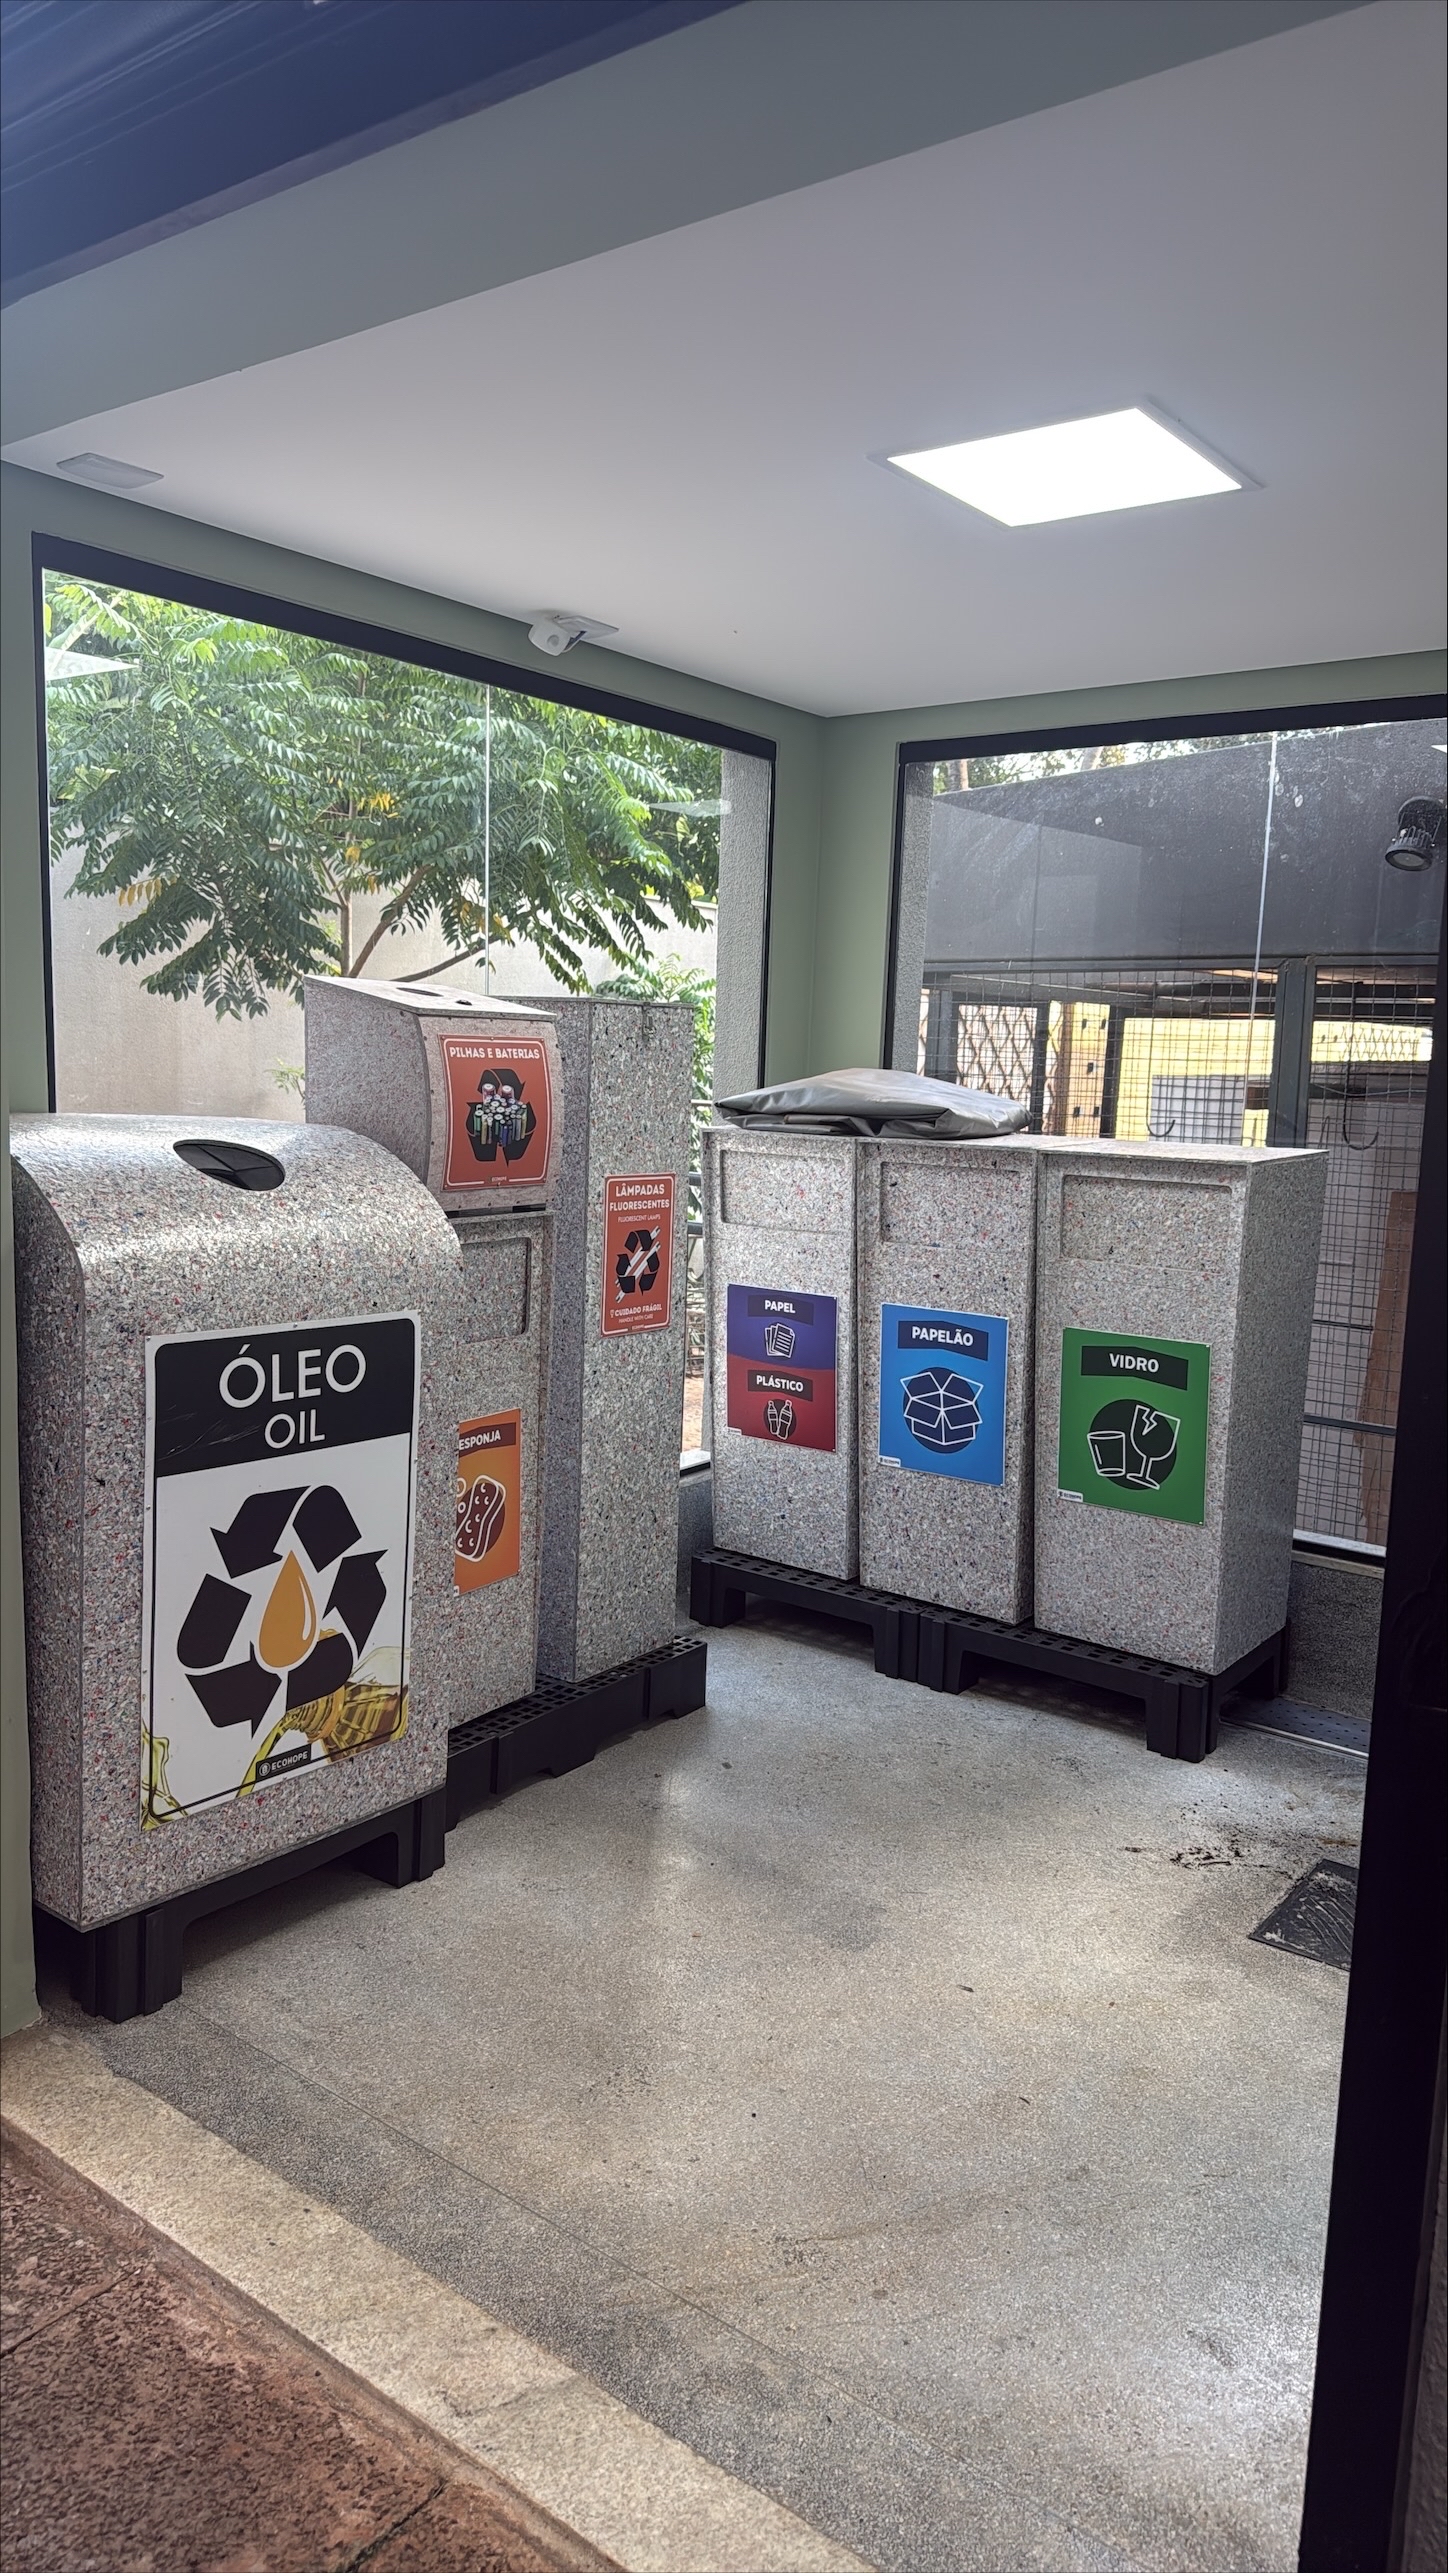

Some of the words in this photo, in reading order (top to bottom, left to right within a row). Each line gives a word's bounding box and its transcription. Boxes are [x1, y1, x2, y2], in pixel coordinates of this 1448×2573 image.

[449, 1047, 485, 1058] PILHAS
[487, 1048, 493, 1058] E
[495, 1048, 540, 1059] BATERIAS
[615, 1183, 665, 1197] LÂMPADAS
[609, 1199, 670, 1211] FLUORESCENTES
[615, 1307, 642, 1317] CUIDADO
[642, 1303, 662, 1312] FRÁGIL
[764, 1300, 796, 1314] PAPEL
[911, 1326, 974, 1346] PAPELÃO
[1109, 1353, 1159, 1373] VIDRO
[219, 1344, 366, 1409] ÓLEO
[756, 1373, 804, 1392] PLÁSTICO
[264, 1409, 325, 1449] OIL
[459, 1429, 501, 1450] ESPONJA
[271, 1751, 308, 1770] ECOHOPE
